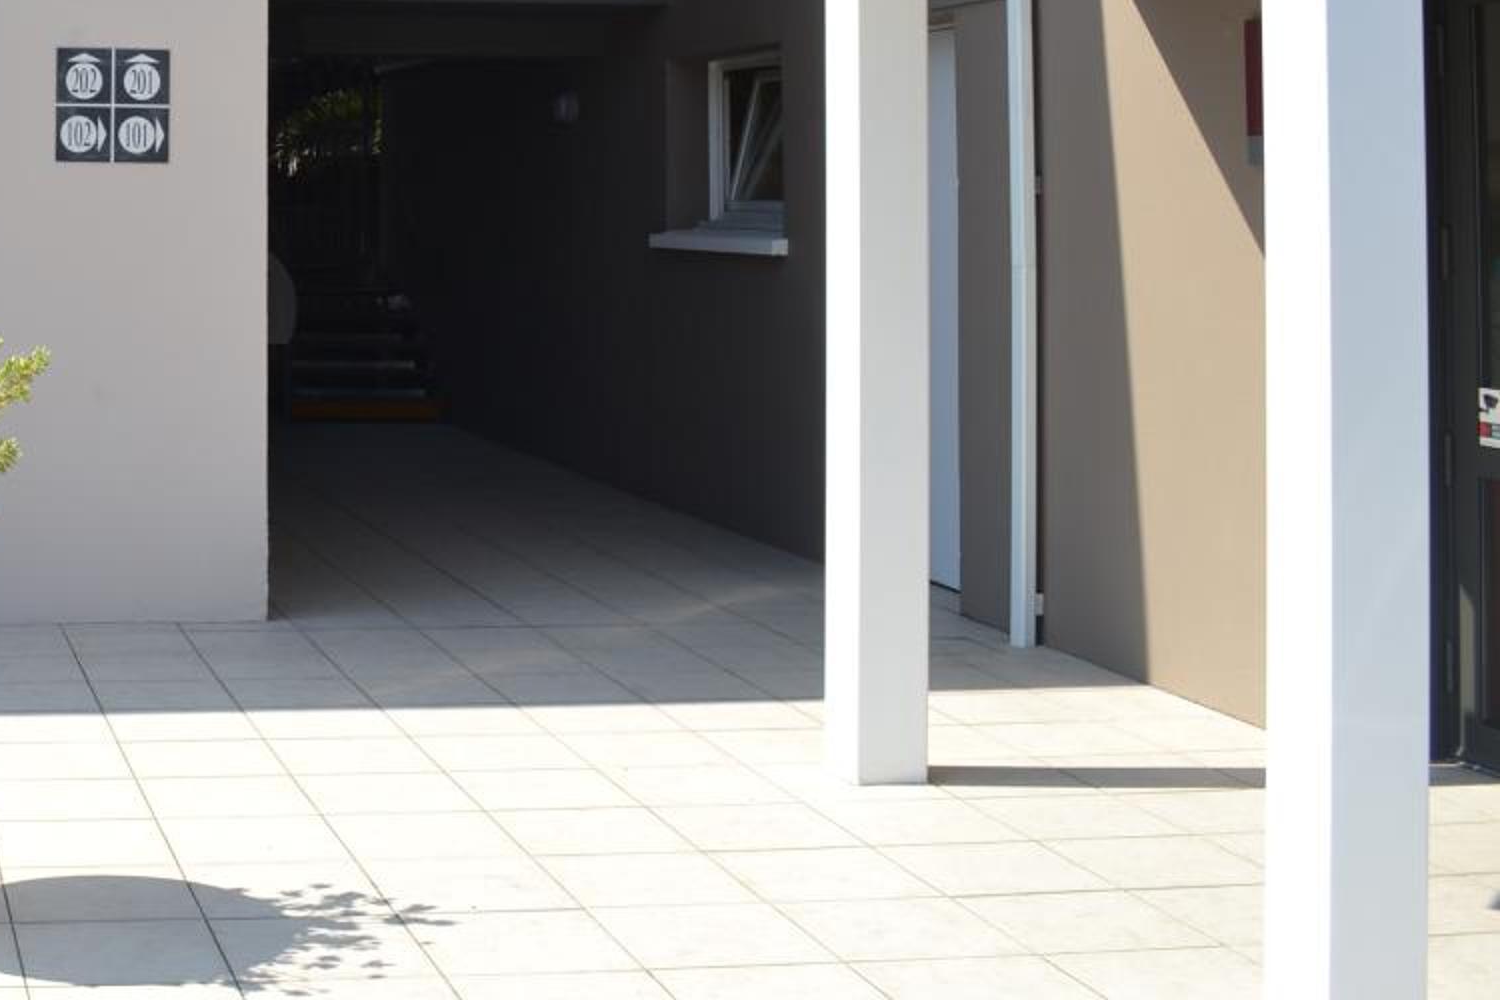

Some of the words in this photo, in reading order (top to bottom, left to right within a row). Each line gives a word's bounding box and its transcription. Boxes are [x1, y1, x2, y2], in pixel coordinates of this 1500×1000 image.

[70, 66, 98, 94] 202
[128, 68, 153, 96] 201
[66, 120, 92, 148] 102
[125, 120, 148, 149] 101
